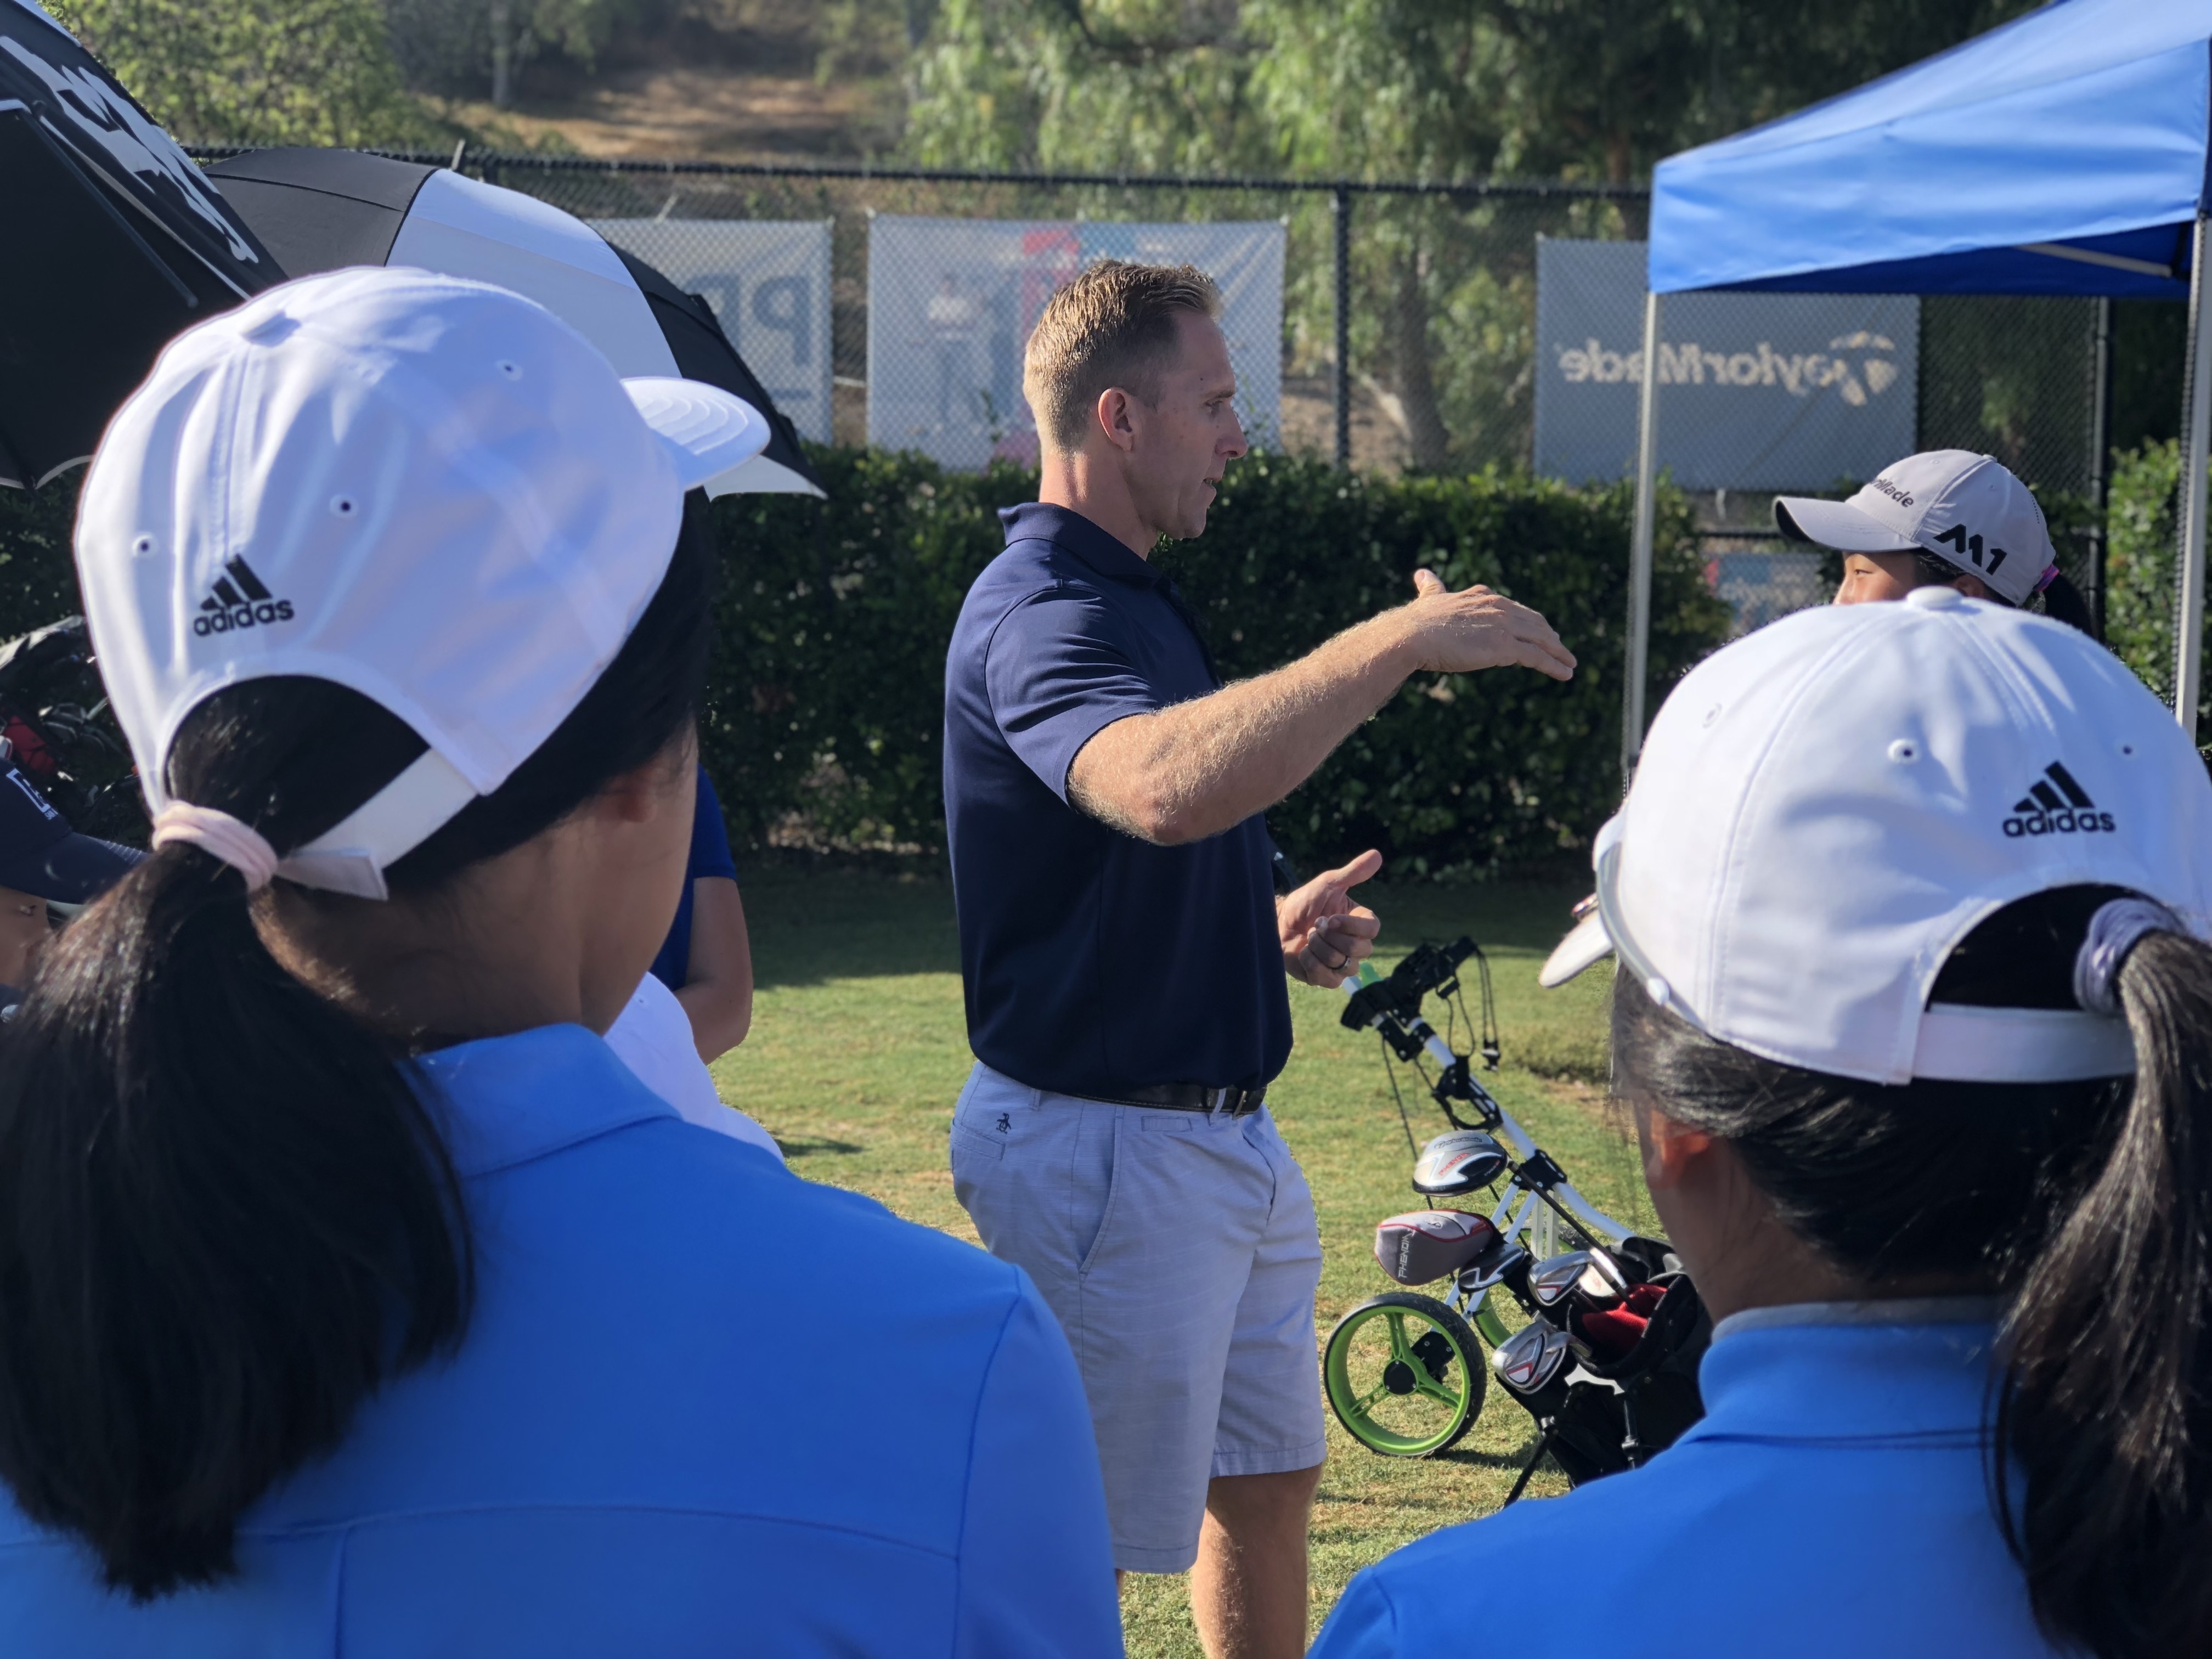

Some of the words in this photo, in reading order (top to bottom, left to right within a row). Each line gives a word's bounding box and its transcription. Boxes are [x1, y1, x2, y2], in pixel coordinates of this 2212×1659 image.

[193, 600, 295, 637] adidas
[2002, 809, 2116, 837] adidas
[1398, 1232, 1414, 1278] PHENOM
